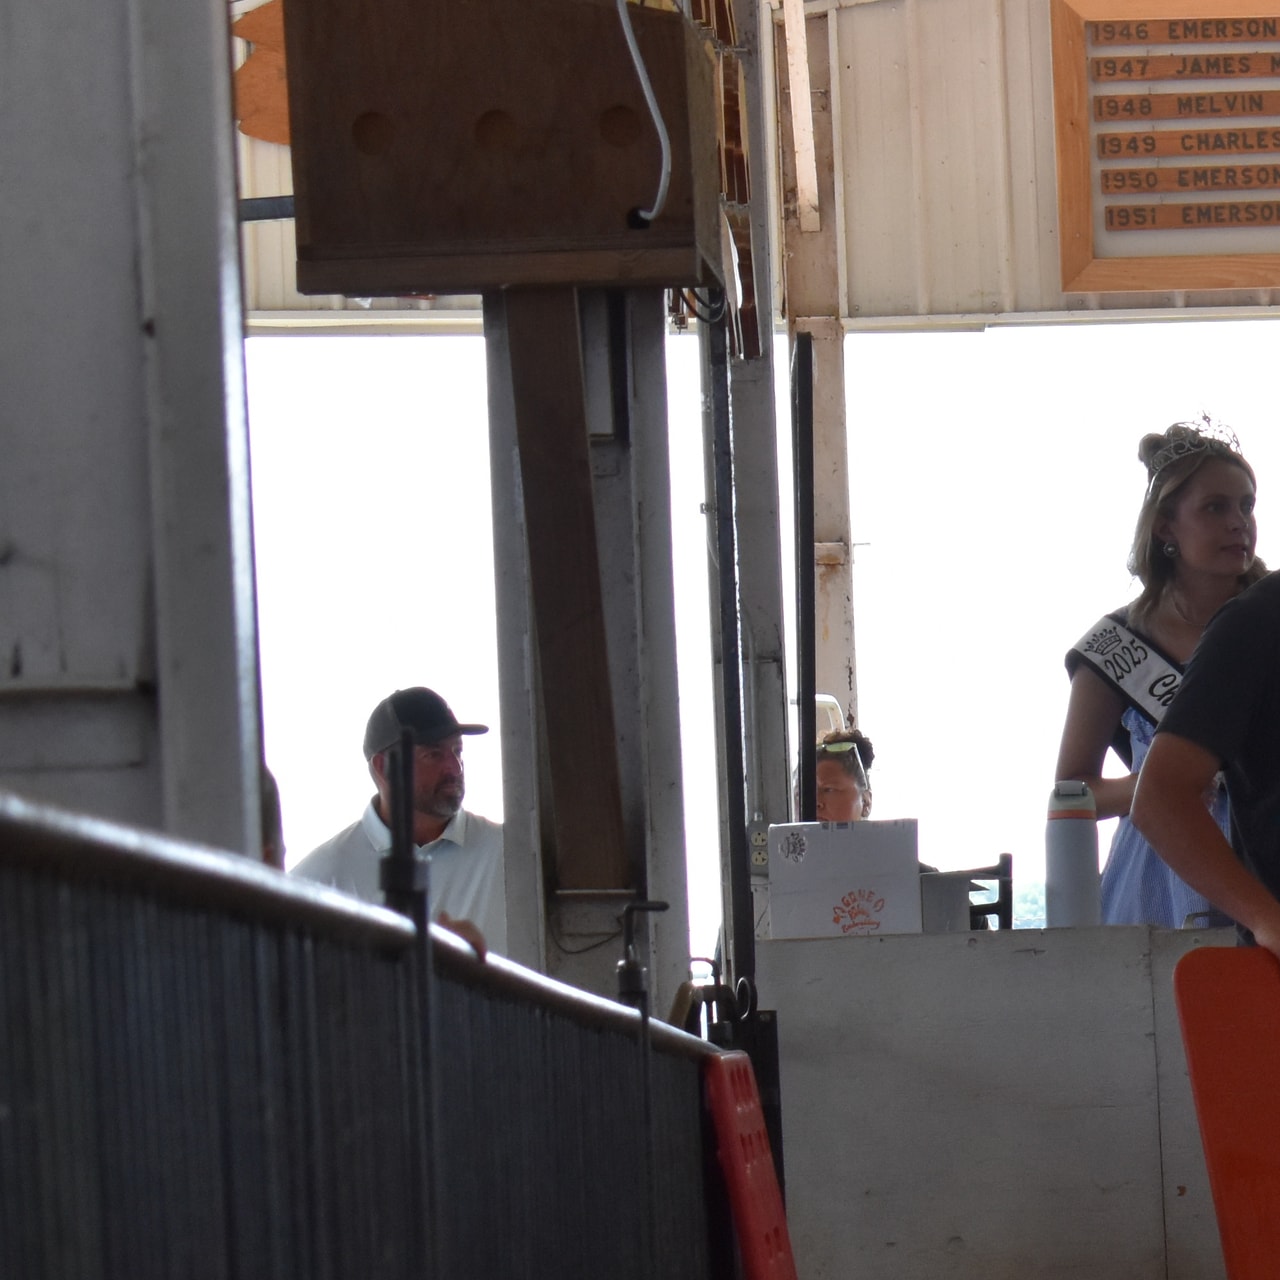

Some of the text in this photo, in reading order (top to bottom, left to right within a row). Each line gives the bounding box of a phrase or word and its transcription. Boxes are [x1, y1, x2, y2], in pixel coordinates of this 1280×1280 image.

[1093, 22, 1149, 41] 1946
[1168, 19, 1277, 40] EMERSON
[1095, 60, 1150, 78] 1947
[1175, 56, 1251, 74] JAMES
[1097, 97, 1153, 116] 1948
[1177, 94, 1264, 114] MELVIN
[1100, 135, 1156, 154] 1949
[1104, 171, 1158, 189] 1950
[1106, 208, 1156, 226] 1951
[1103, 639, 1148, 683] 2025
